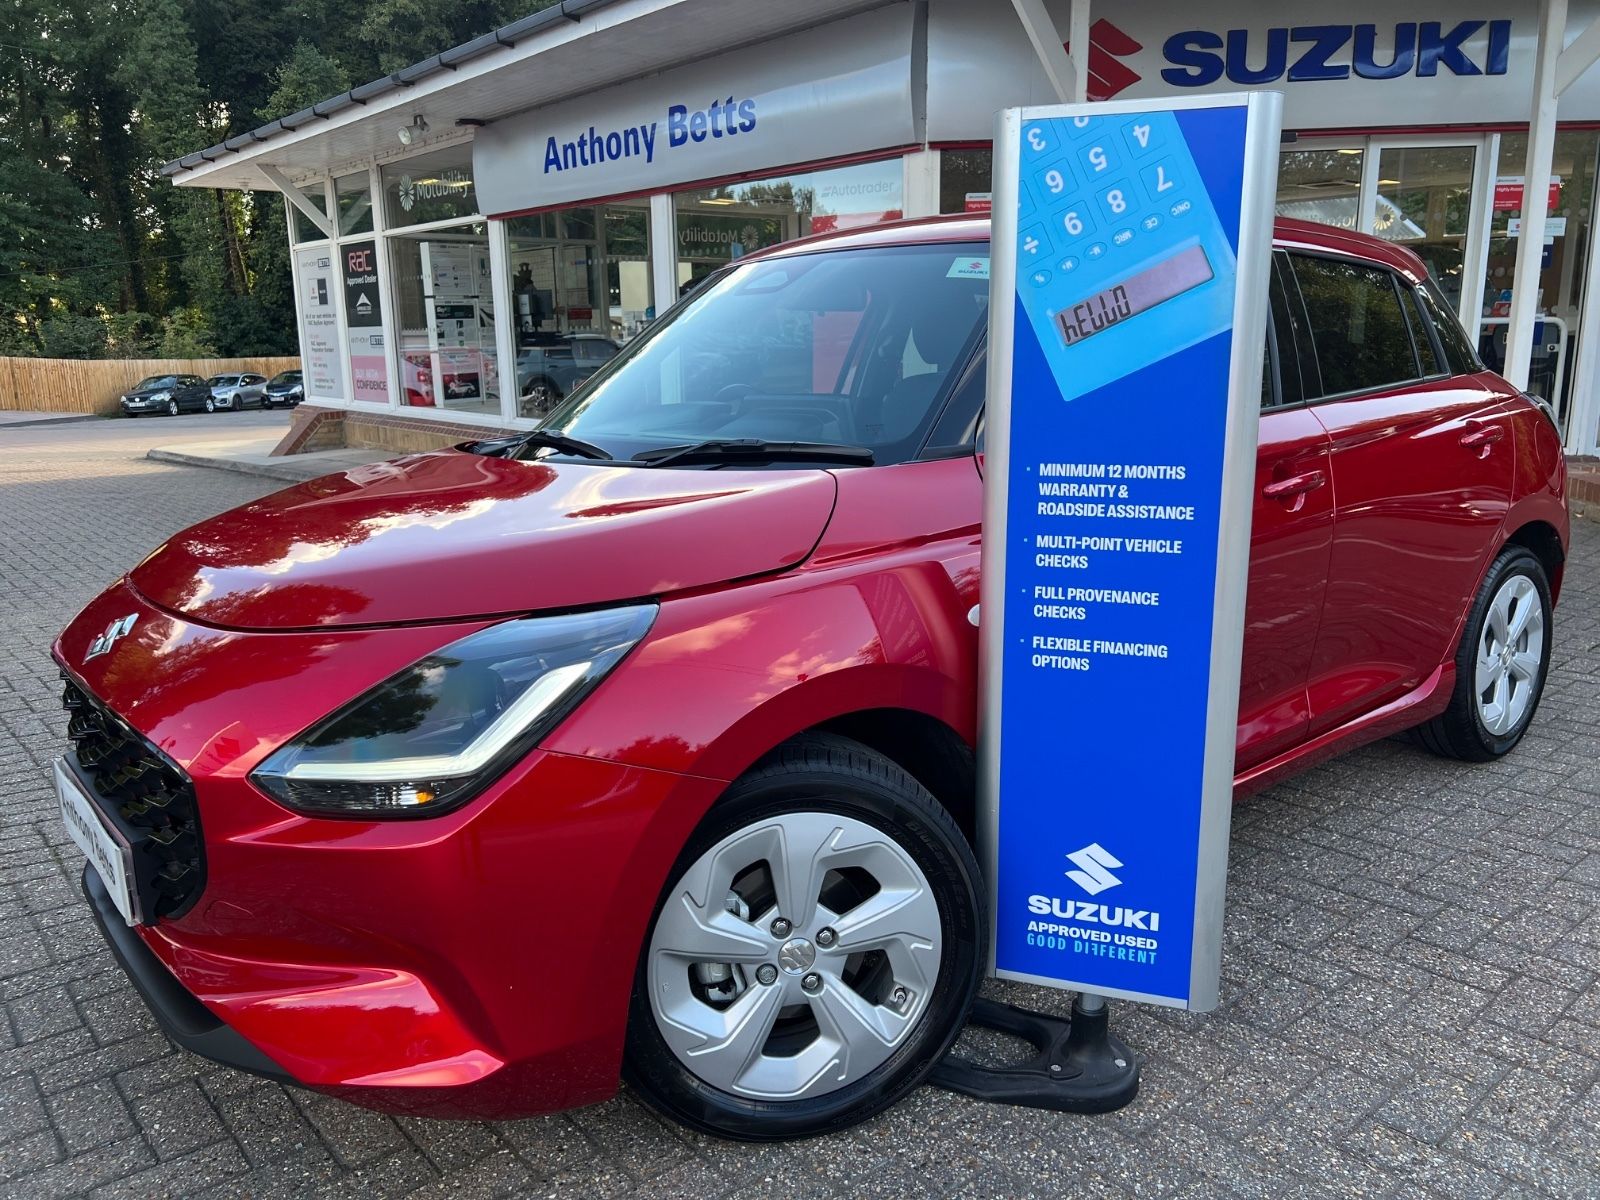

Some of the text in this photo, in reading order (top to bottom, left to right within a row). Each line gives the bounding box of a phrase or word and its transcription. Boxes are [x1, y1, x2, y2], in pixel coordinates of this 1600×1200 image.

[1161, 20, 1512, 87] SUZUKI
[544, 96, 756, 174] Anthony Betts
[1132, 124, 1150, 148] 4
[1088, 147, 1107, 172] 5
[417, 170, 469, 200] Motability
[831, 181, 895, 197] Autotrader
[1106, 189, 1126, 213] 8
[1145, 217, 1158, 229] CE
[1039, 463, 1186, 480] MINIMUM 12 MONTHS
[1039, 483, 1129, 498] WARRANTY &
[1038, 502, 1194, 520] ROADSIDE ASSISTANCE
[1036, 535, 1182, 554] MULTI-POINT VEHICLE
[1035, 554, 1088, 569] CHECKS
[1034, 586, 1159, 606] FULL PROVENANCE
[1034, 604, 1086, 620] CHECKS
[1032, 636, 1168, 658] FLEXIBLE FINANCING
[1032, 654, 1090, 671] OPTIONS
[1028, 894, 1160, 931] SUZUKI
[1027, 921, 1158, 950] APPROVED USED
[1027, 933, 1157, 965] GOOD DIFFERENT
